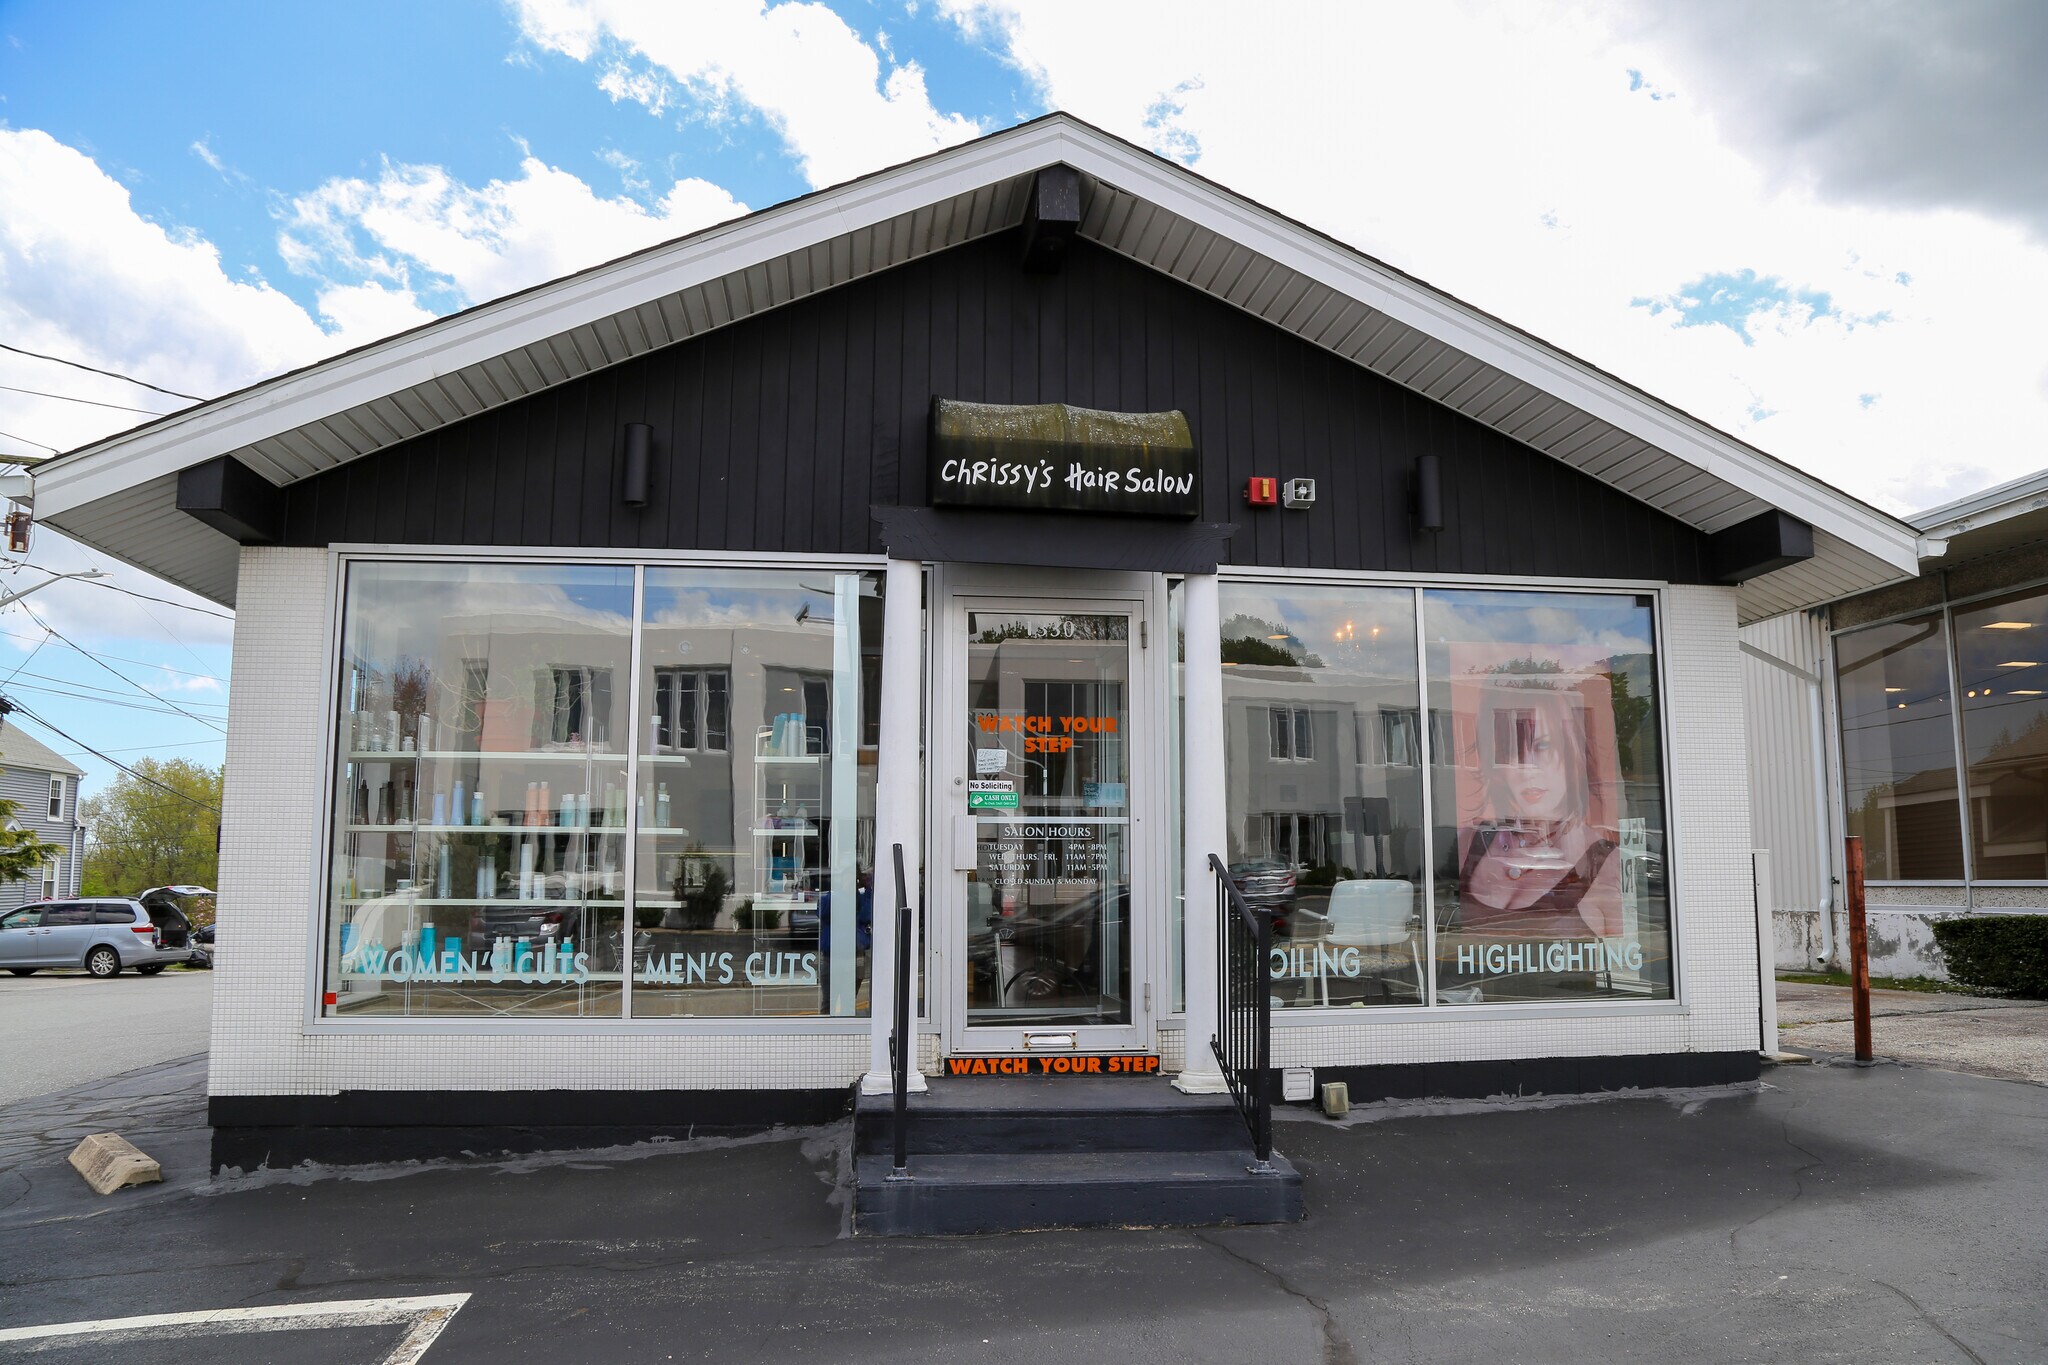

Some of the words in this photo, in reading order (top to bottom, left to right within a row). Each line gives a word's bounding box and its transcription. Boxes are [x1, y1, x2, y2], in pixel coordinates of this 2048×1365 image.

[977, 716, 1052, 733] WATCH
[1060, 716, 1118, 733] YOUR
[1024, 737, 1073, 753] STEP
[980, 782, 1012, 791] Soliciting
[1004, 827, 1044, 837] SALON
[1048, 827, 1091, 837] HOURS
[359, 951, 504, 984] WOMEN'S
[516, 952, 590, 984] CUTS
[644, 952, 734, 984] MEN'S
[745, 952, 818, 984] CUTS
[1270, 947, 1361, 978] OILING
[1457, 942, 1643, 975] HIGHLIGHTING
[950, 1058, 1028, 1075] WATCH
[1039, 1057, 1102, 1073] YOUR
[1108, 1056, 1159, 1073] STEP
